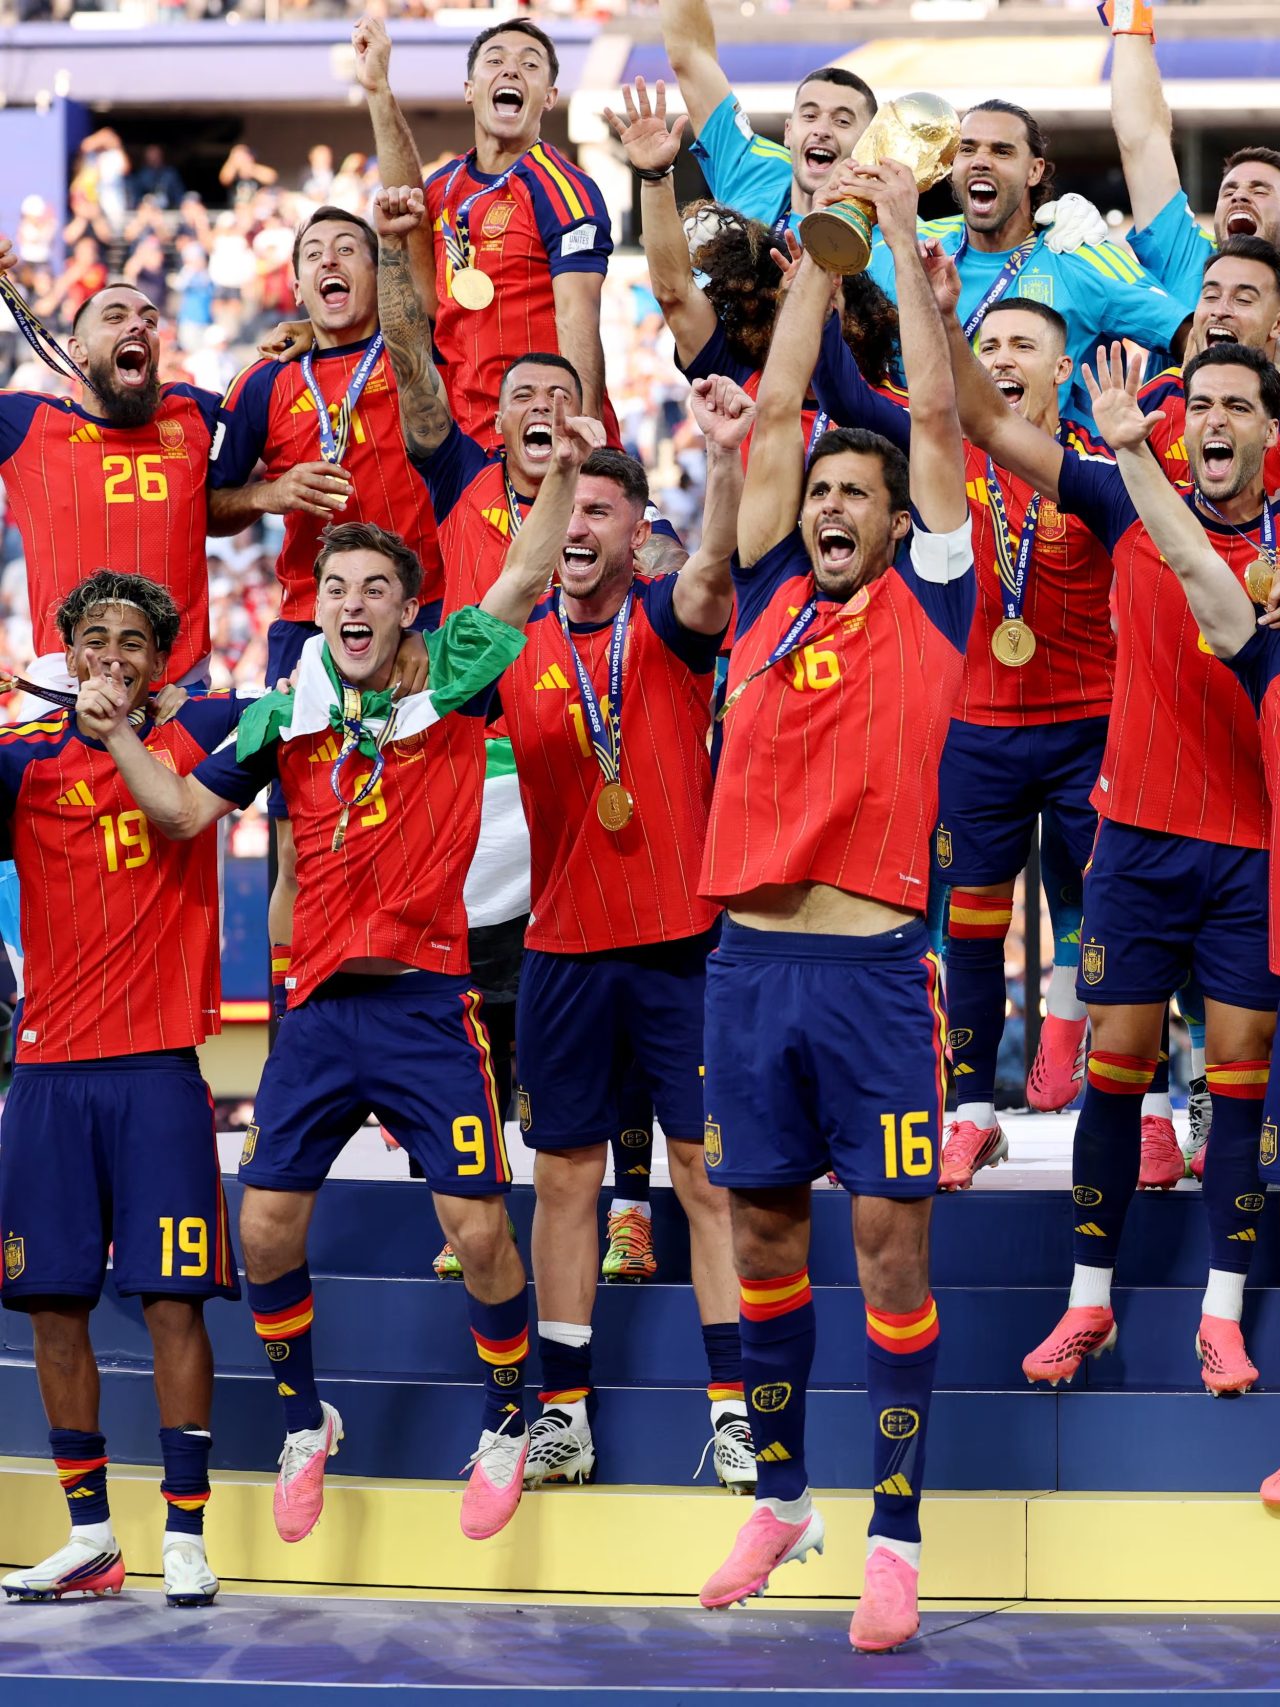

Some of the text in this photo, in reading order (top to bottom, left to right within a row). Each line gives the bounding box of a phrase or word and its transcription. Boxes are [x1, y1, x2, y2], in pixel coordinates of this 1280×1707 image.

[964, 316, 979, 337] ORLD
[987, 278, 1007, 304] 2026
[14, 310, 26, 327] FIFA
[23, 325, 40, 350] WORLD
[304, 369, 318, 395] WORLD
[353, 371, 366, 389] FIFA
[363, 349, 378, 374] WORLD
[373, 335, 383, 353] CUP
[315, 394, 325, 411] CUP
[319, 411, 329, 435] 2026
[103, 454, 168, 503] 26
[1019, 538, 1030, 569] 2026
[1017, 569, 1026, 588] CUP
[614, 624, 623, 642] CUP
[775, 607, 814, 657] FIFA WORLD CUP
[612, 642, 621, 676] WORLD
[788, 634, 842, 692] 16
[582, 685, 592, 701] CUP
[587, 702, 601, 733] 2026
[367, 762, 382, 791] 2026
[353, 773, 387, 827] 9
[99, 809, 151, 872] 19
[452, 1115, 485, 1176] 9
[880, 1111, 933, 1178] 16
[159, 1216, 208, 1277] 19
[887, 1414, 909, 1424] RF
[887, 1423, 909, 1433] EF
